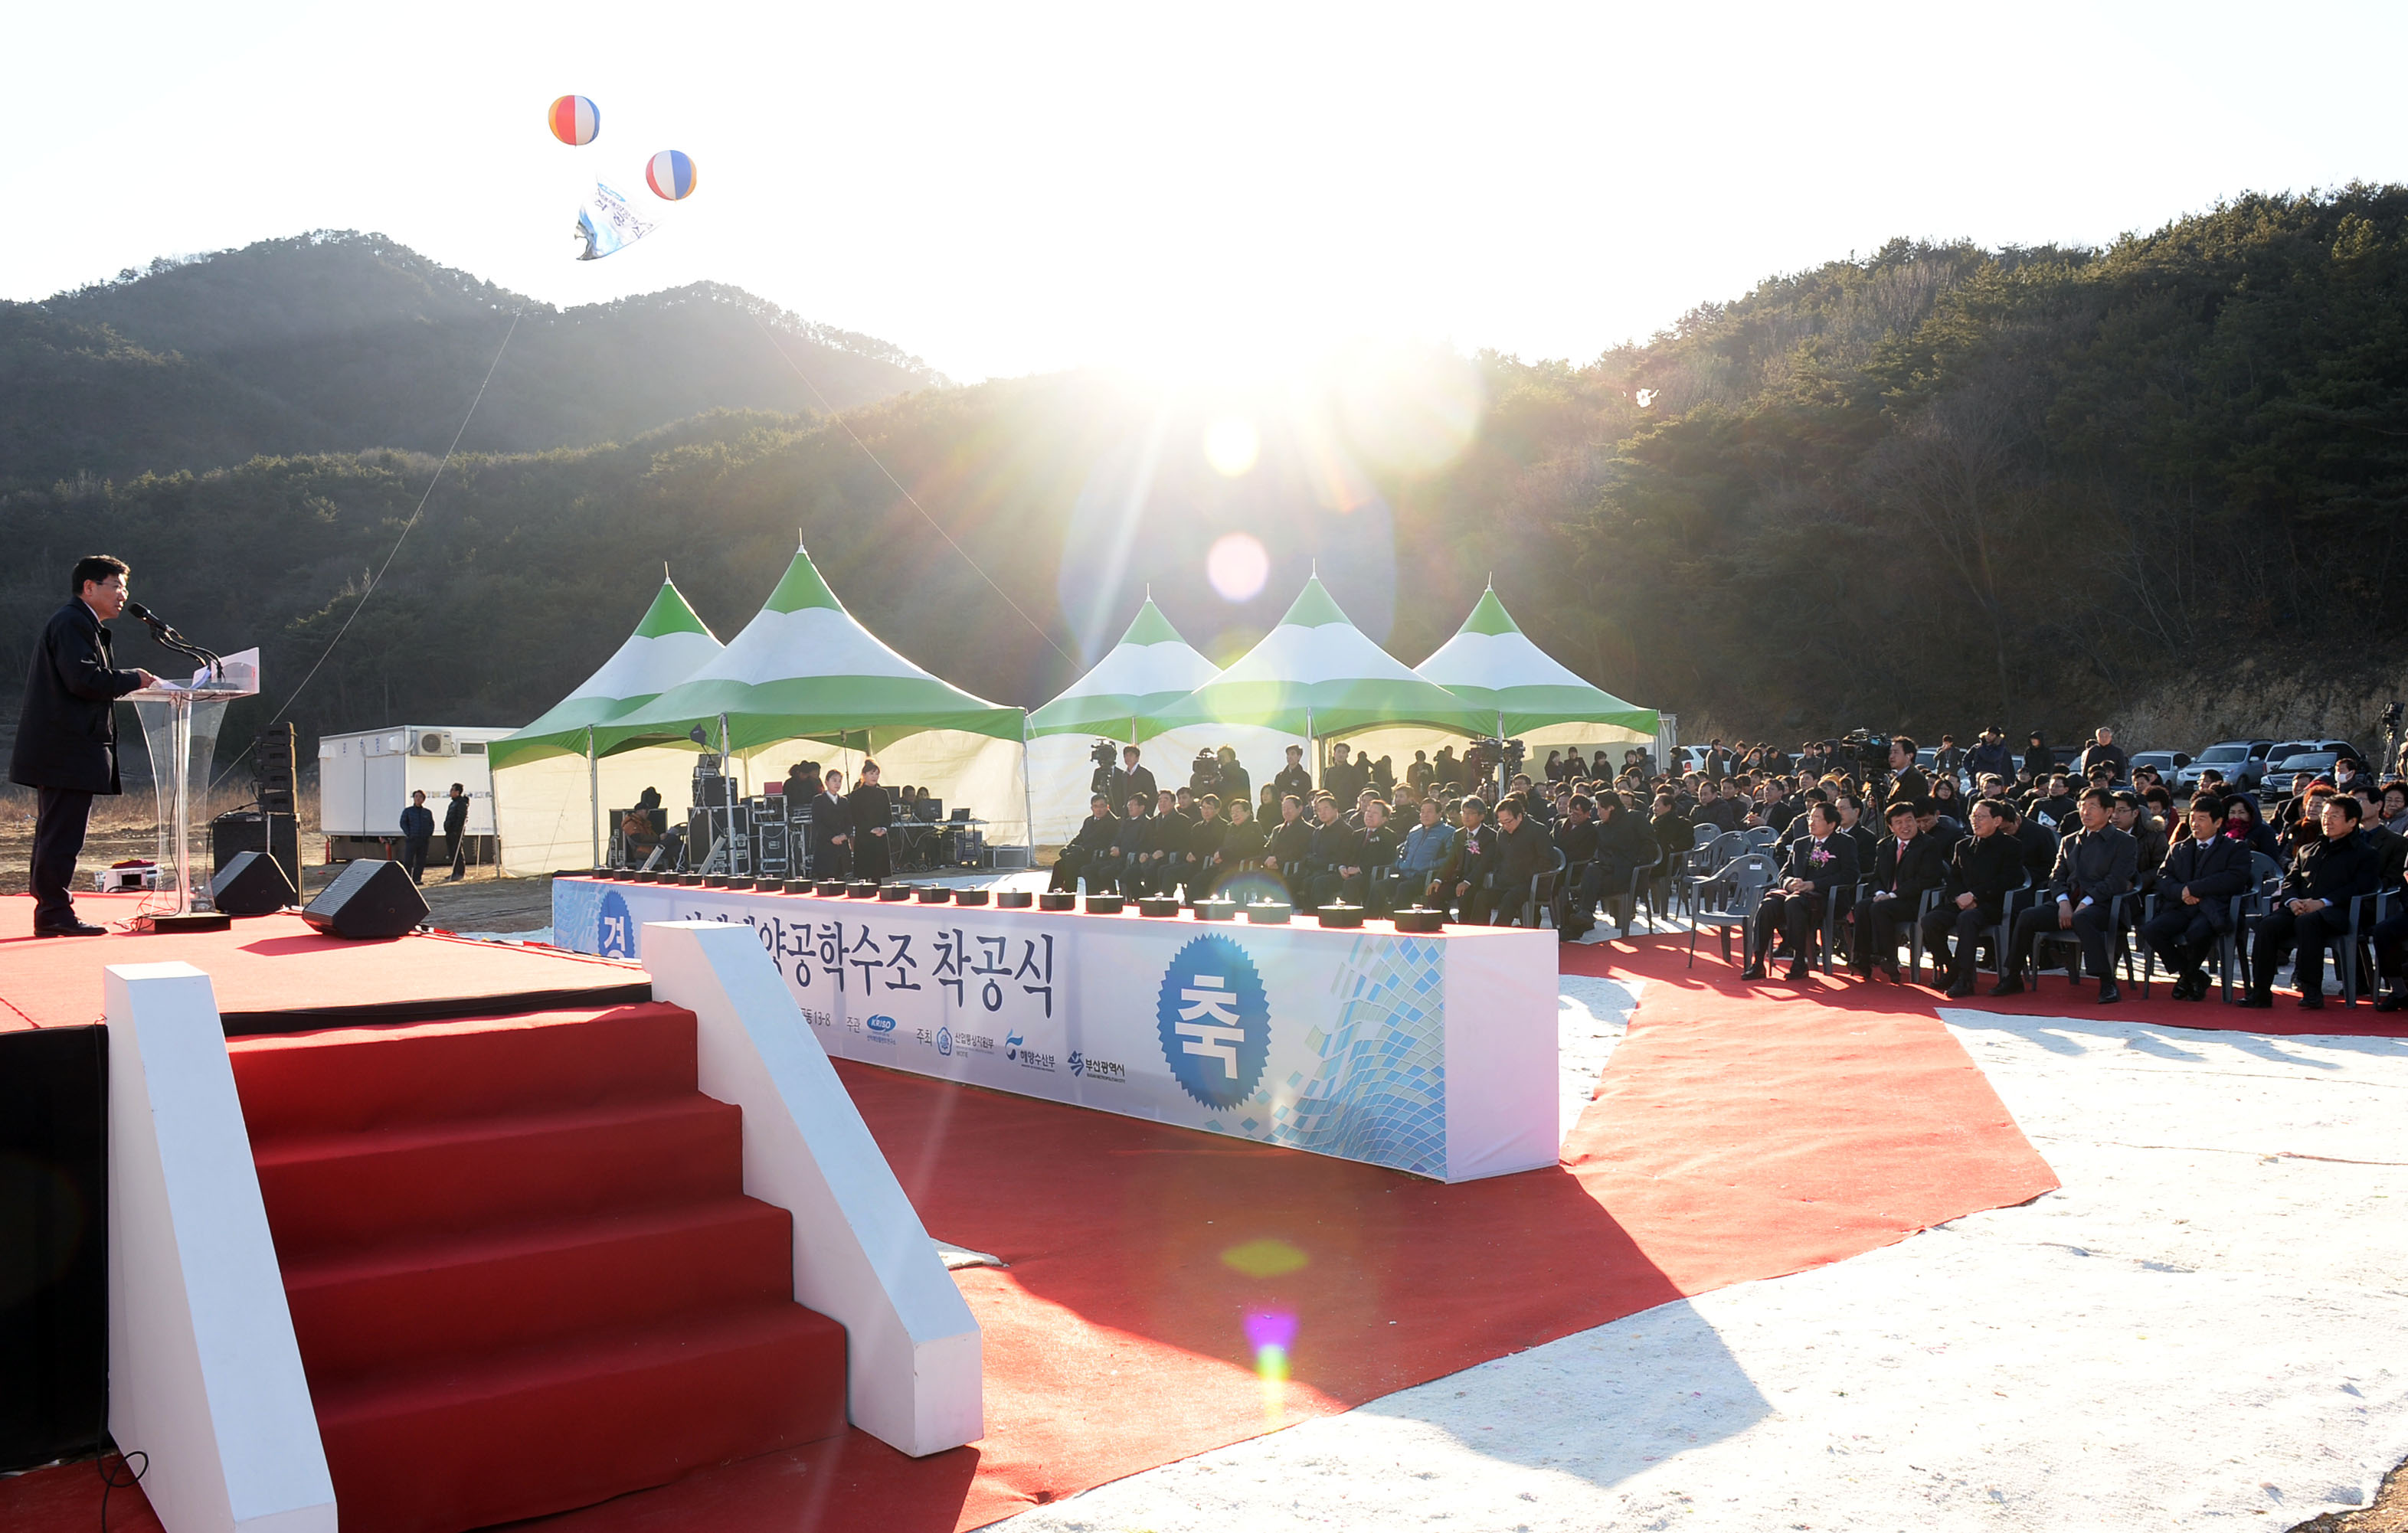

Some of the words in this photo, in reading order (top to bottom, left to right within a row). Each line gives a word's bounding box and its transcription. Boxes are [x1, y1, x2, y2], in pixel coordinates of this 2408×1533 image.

[685, 911, 922, 997] 양공학수조
[932, 928, 1053, 1019] 착공식
[814, 1011, 831, 1027] 13-8
[846, 1016, 861, 1034] 주관
[871, 1018, 891, 1029] KRISO
[1174, 974, 1245, 1080] 축
[916, 1028, 933, 1047] 주최
[1020, 1049, 1055, 1068] 해양수산부
[1085, 1058, 1125, 1077] 부산광역시
